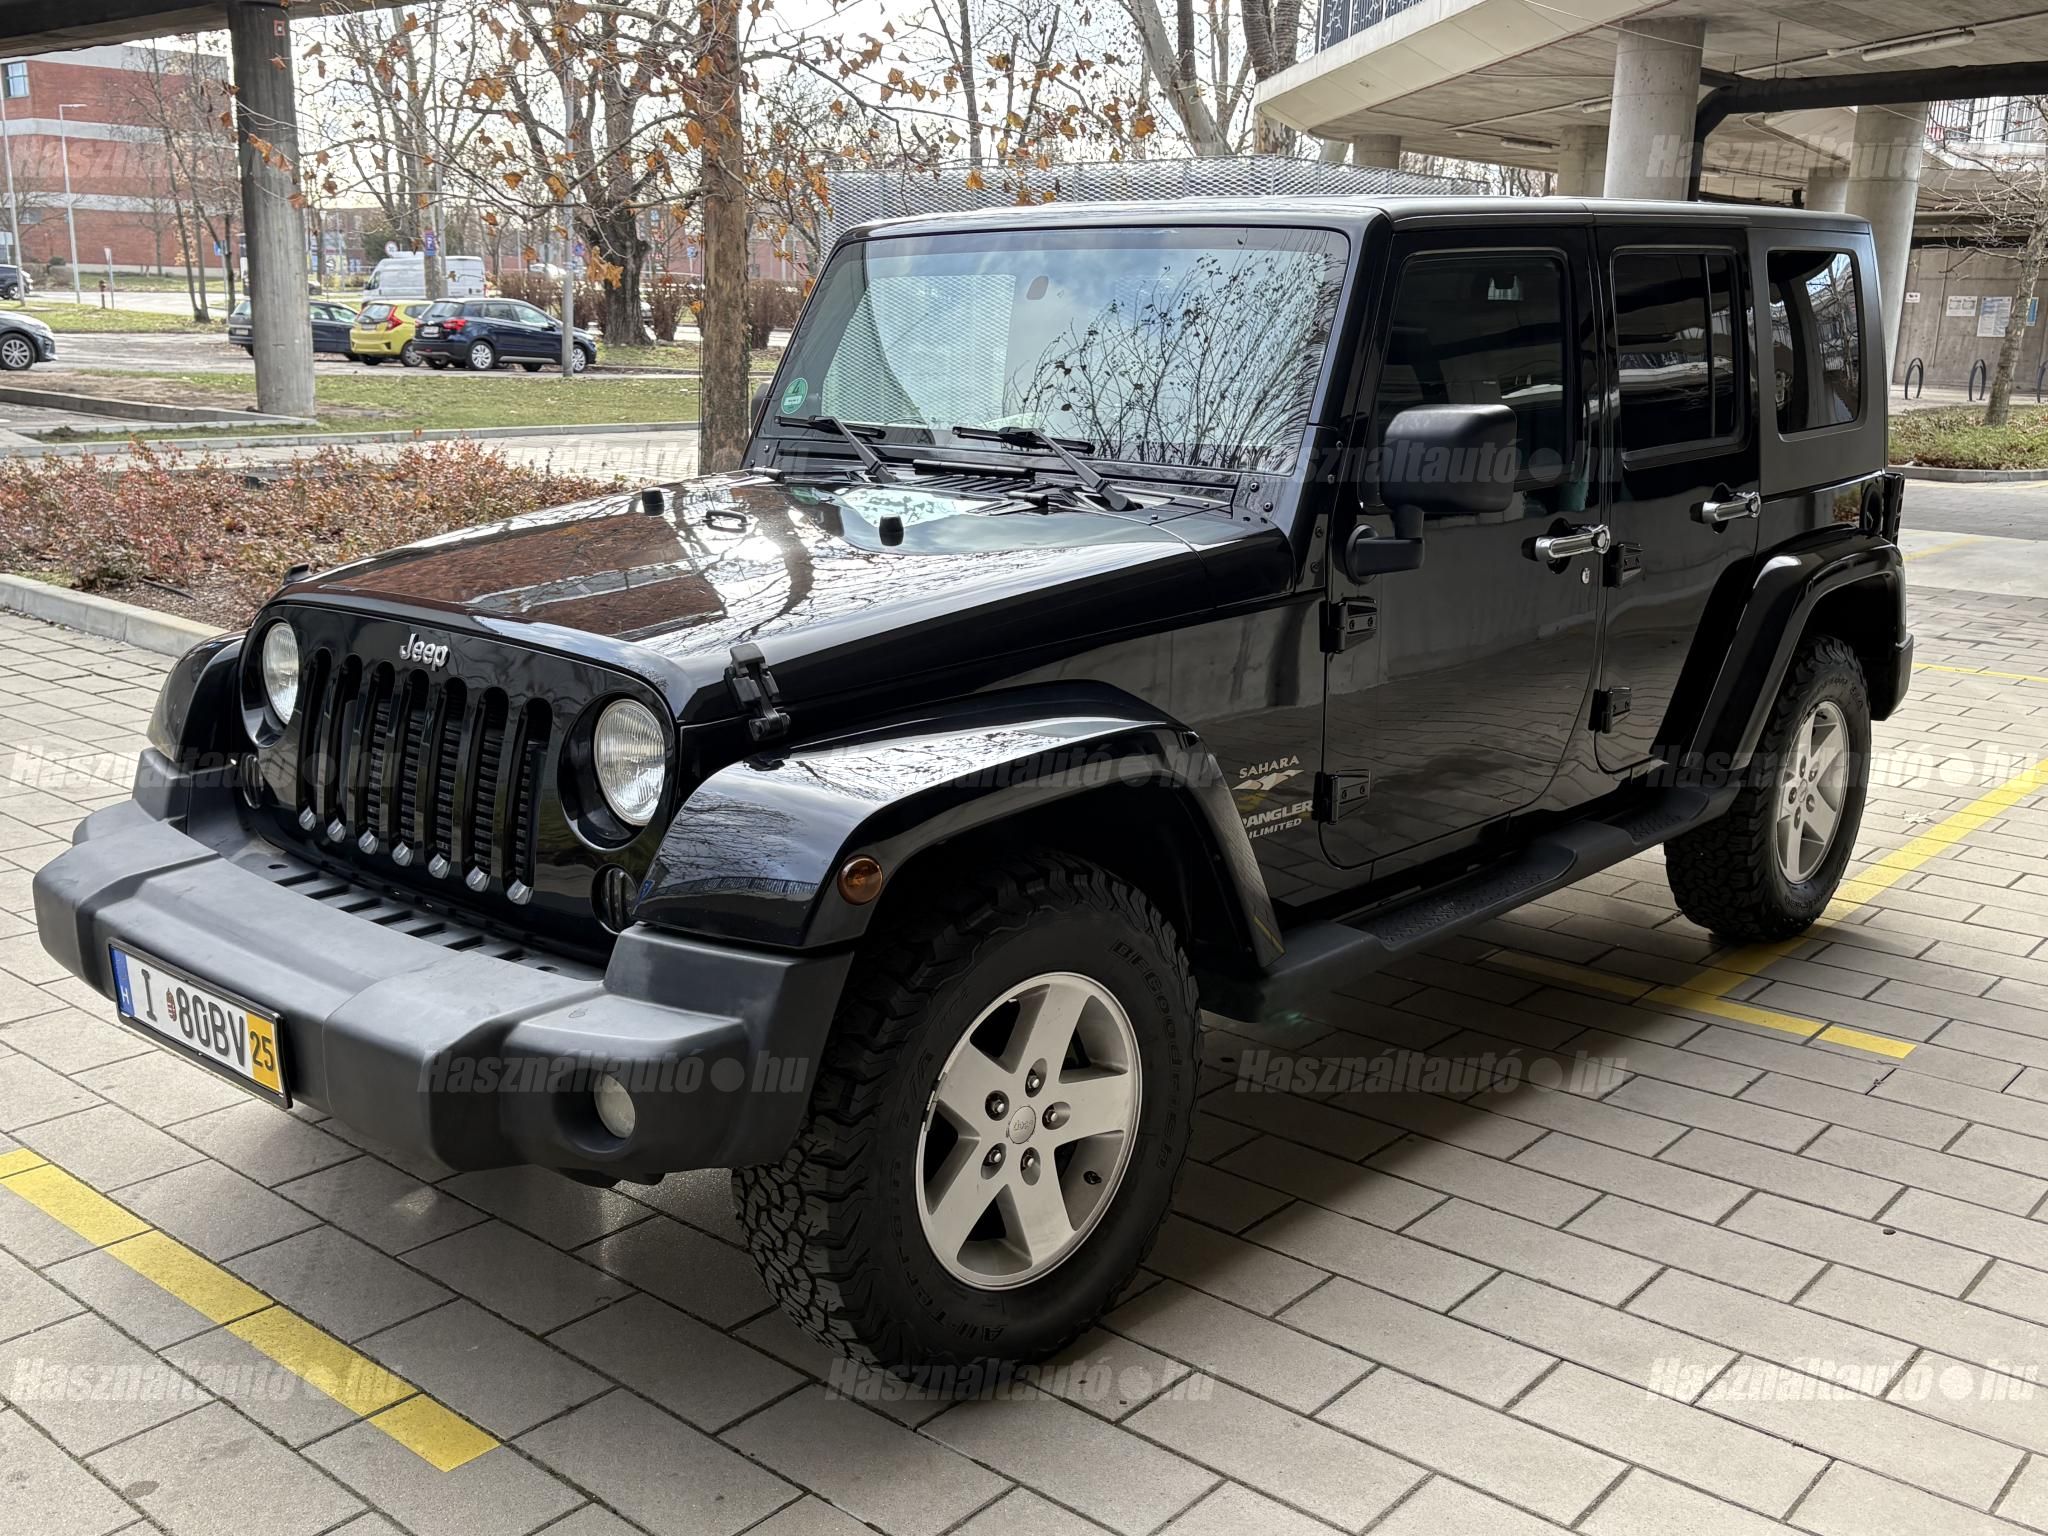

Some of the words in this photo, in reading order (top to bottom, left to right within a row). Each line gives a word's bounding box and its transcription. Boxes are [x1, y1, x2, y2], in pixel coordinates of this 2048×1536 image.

[399, 633, 448, 672] Jeep
[1239, 755, 1300, 779] SAHARA
[1242, 800, 1313, 828] ANGLER
[1249, 818, 1302, 840] LIMITED
[249, 1030, 274, 1072] 25
